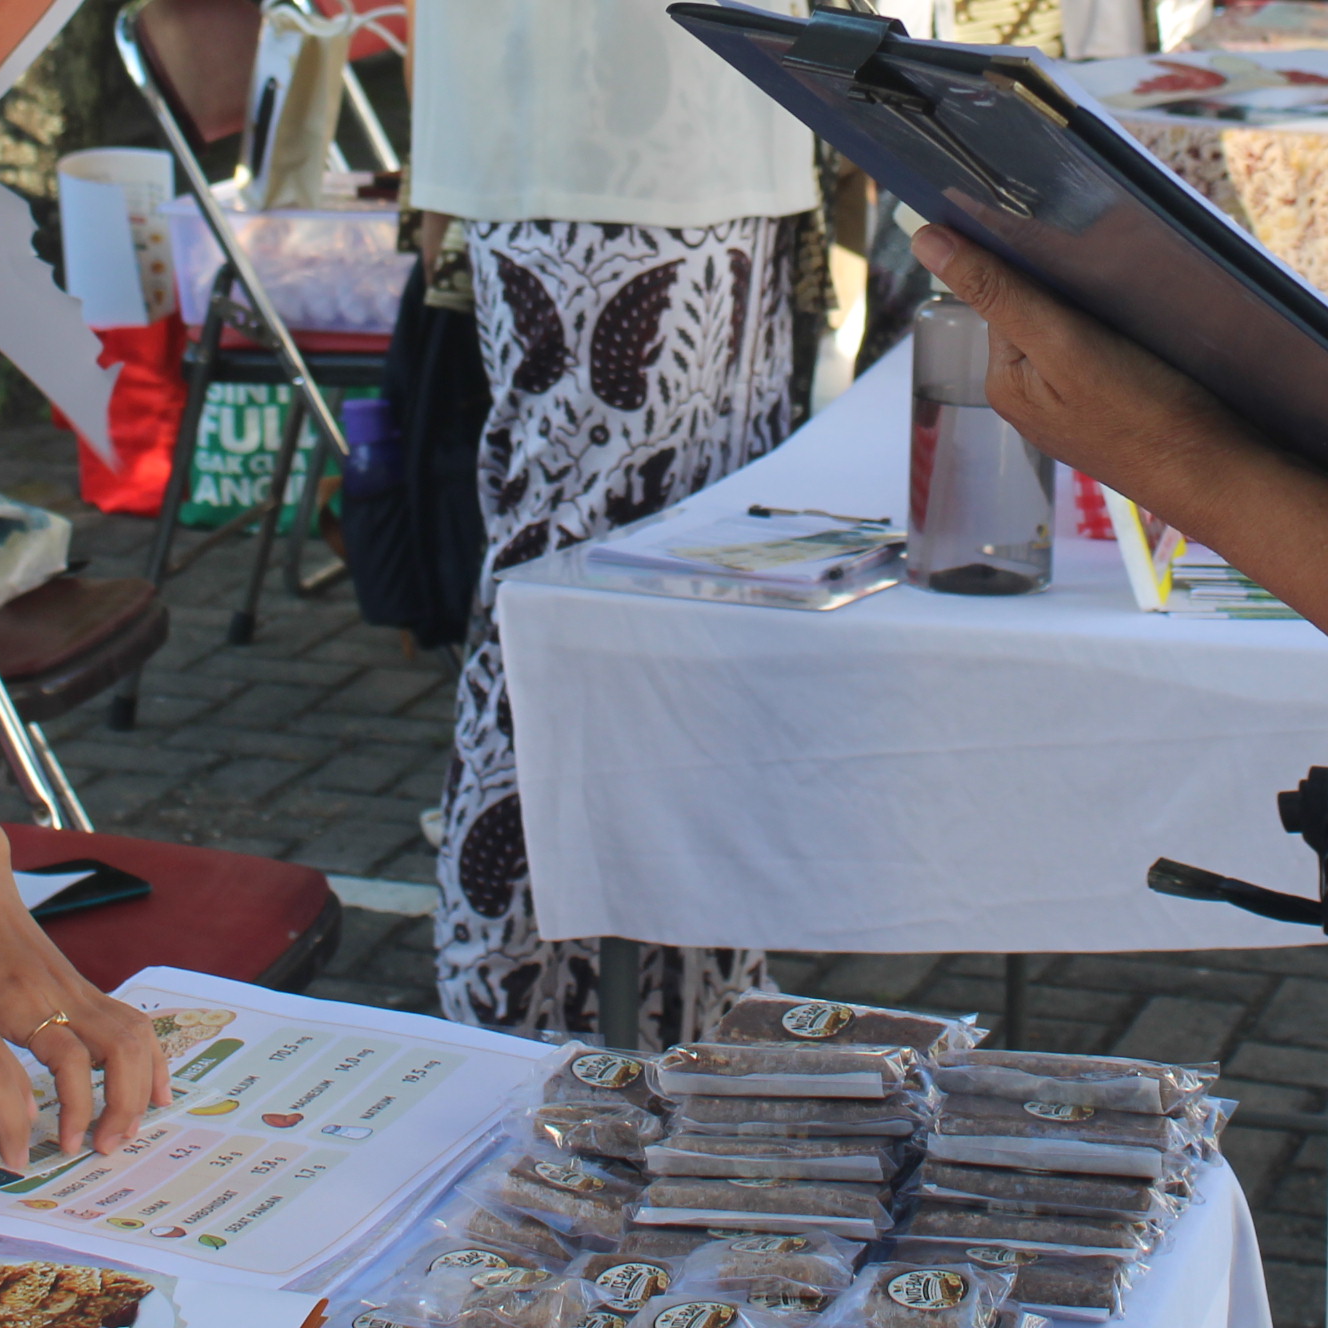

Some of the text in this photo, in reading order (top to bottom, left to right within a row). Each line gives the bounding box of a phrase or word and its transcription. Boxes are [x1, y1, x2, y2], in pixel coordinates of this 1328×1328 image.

[179, 1057, 218, 1080] INERAL
[401, 1069, 428, 1083] 19,5
[226, 1075, 261, 1096] KALIUM
[123, 1138, 152, 1154] 94,7
